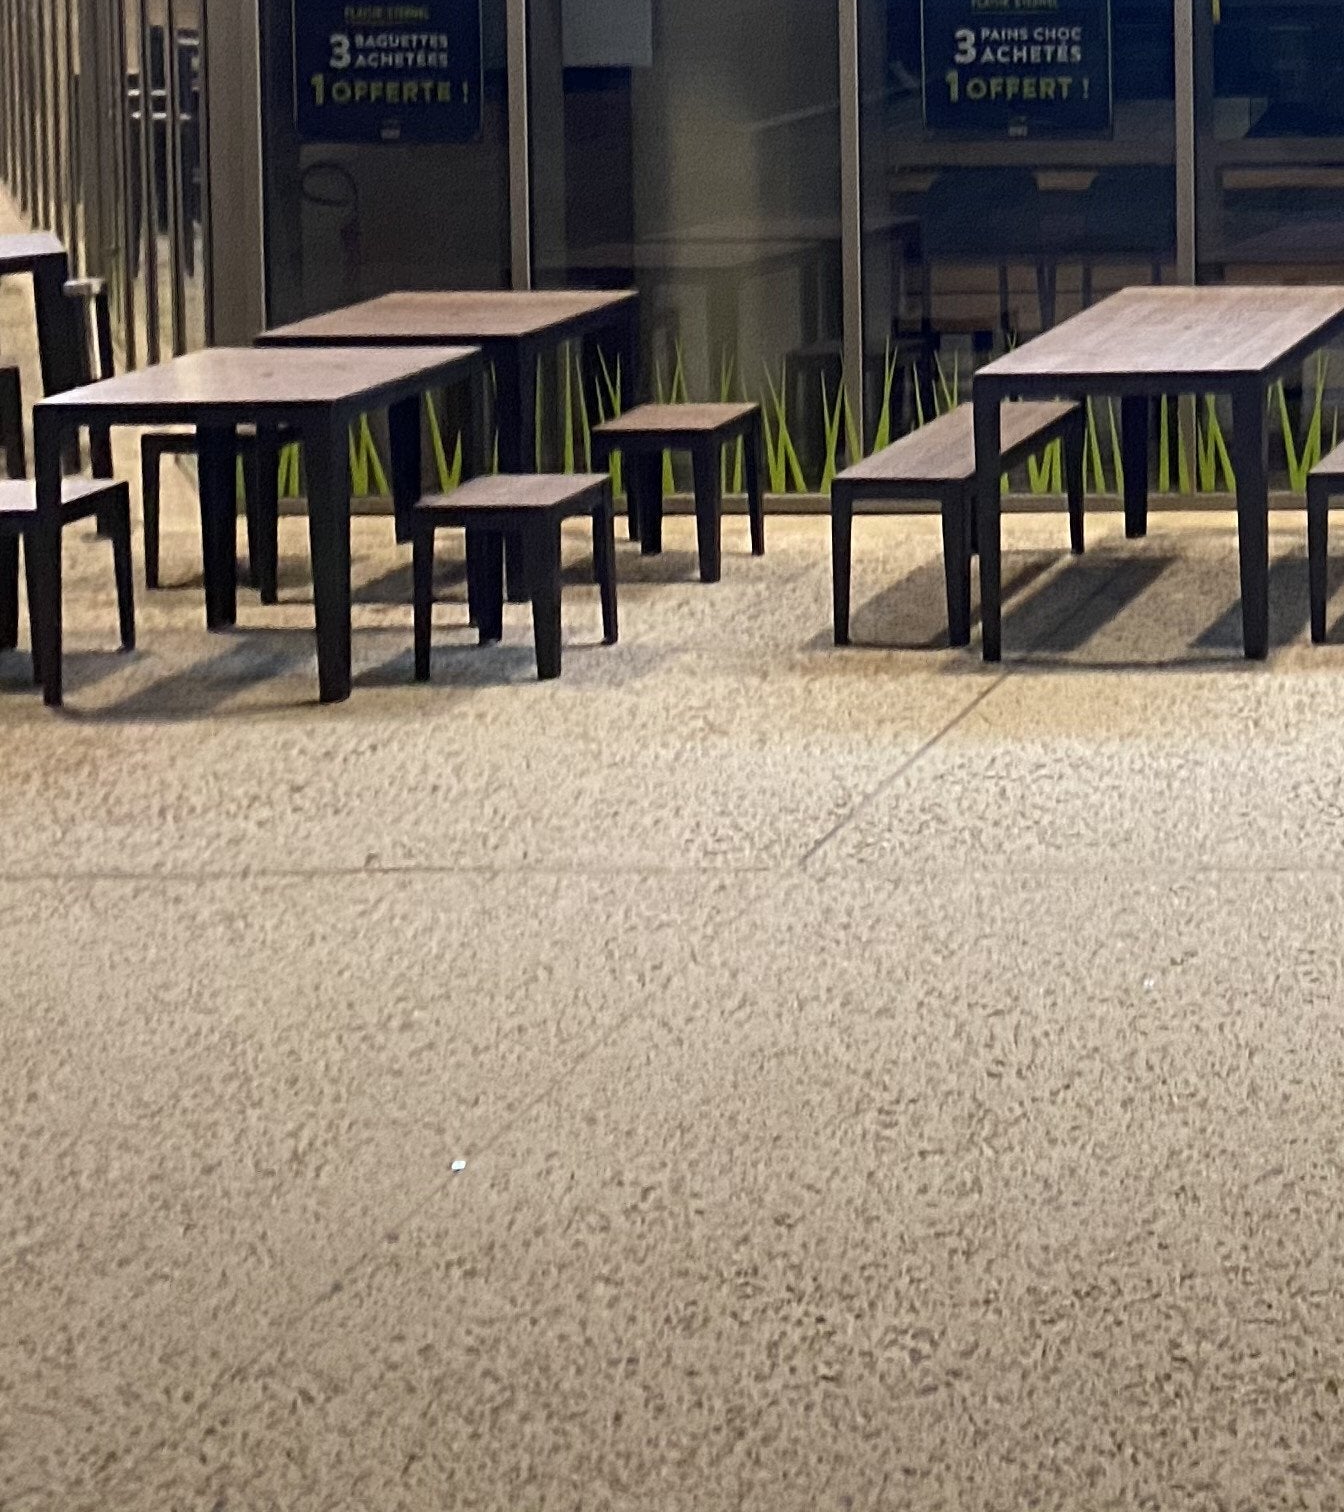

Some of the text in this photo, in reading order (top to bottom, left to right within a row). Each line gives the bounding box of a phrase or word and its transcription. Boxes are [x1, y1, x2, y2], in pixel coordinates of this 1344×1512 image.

[328, 31, 449, 69] 3 BAGUETTES
[953, 26, 1083, 65] 3 PAINS CHOC
[979, 43, 1083, 64] ACHETÉS
[330, 80, 452, 105] OFFERTE
[965, 75, 1074, 102] OFFERT
